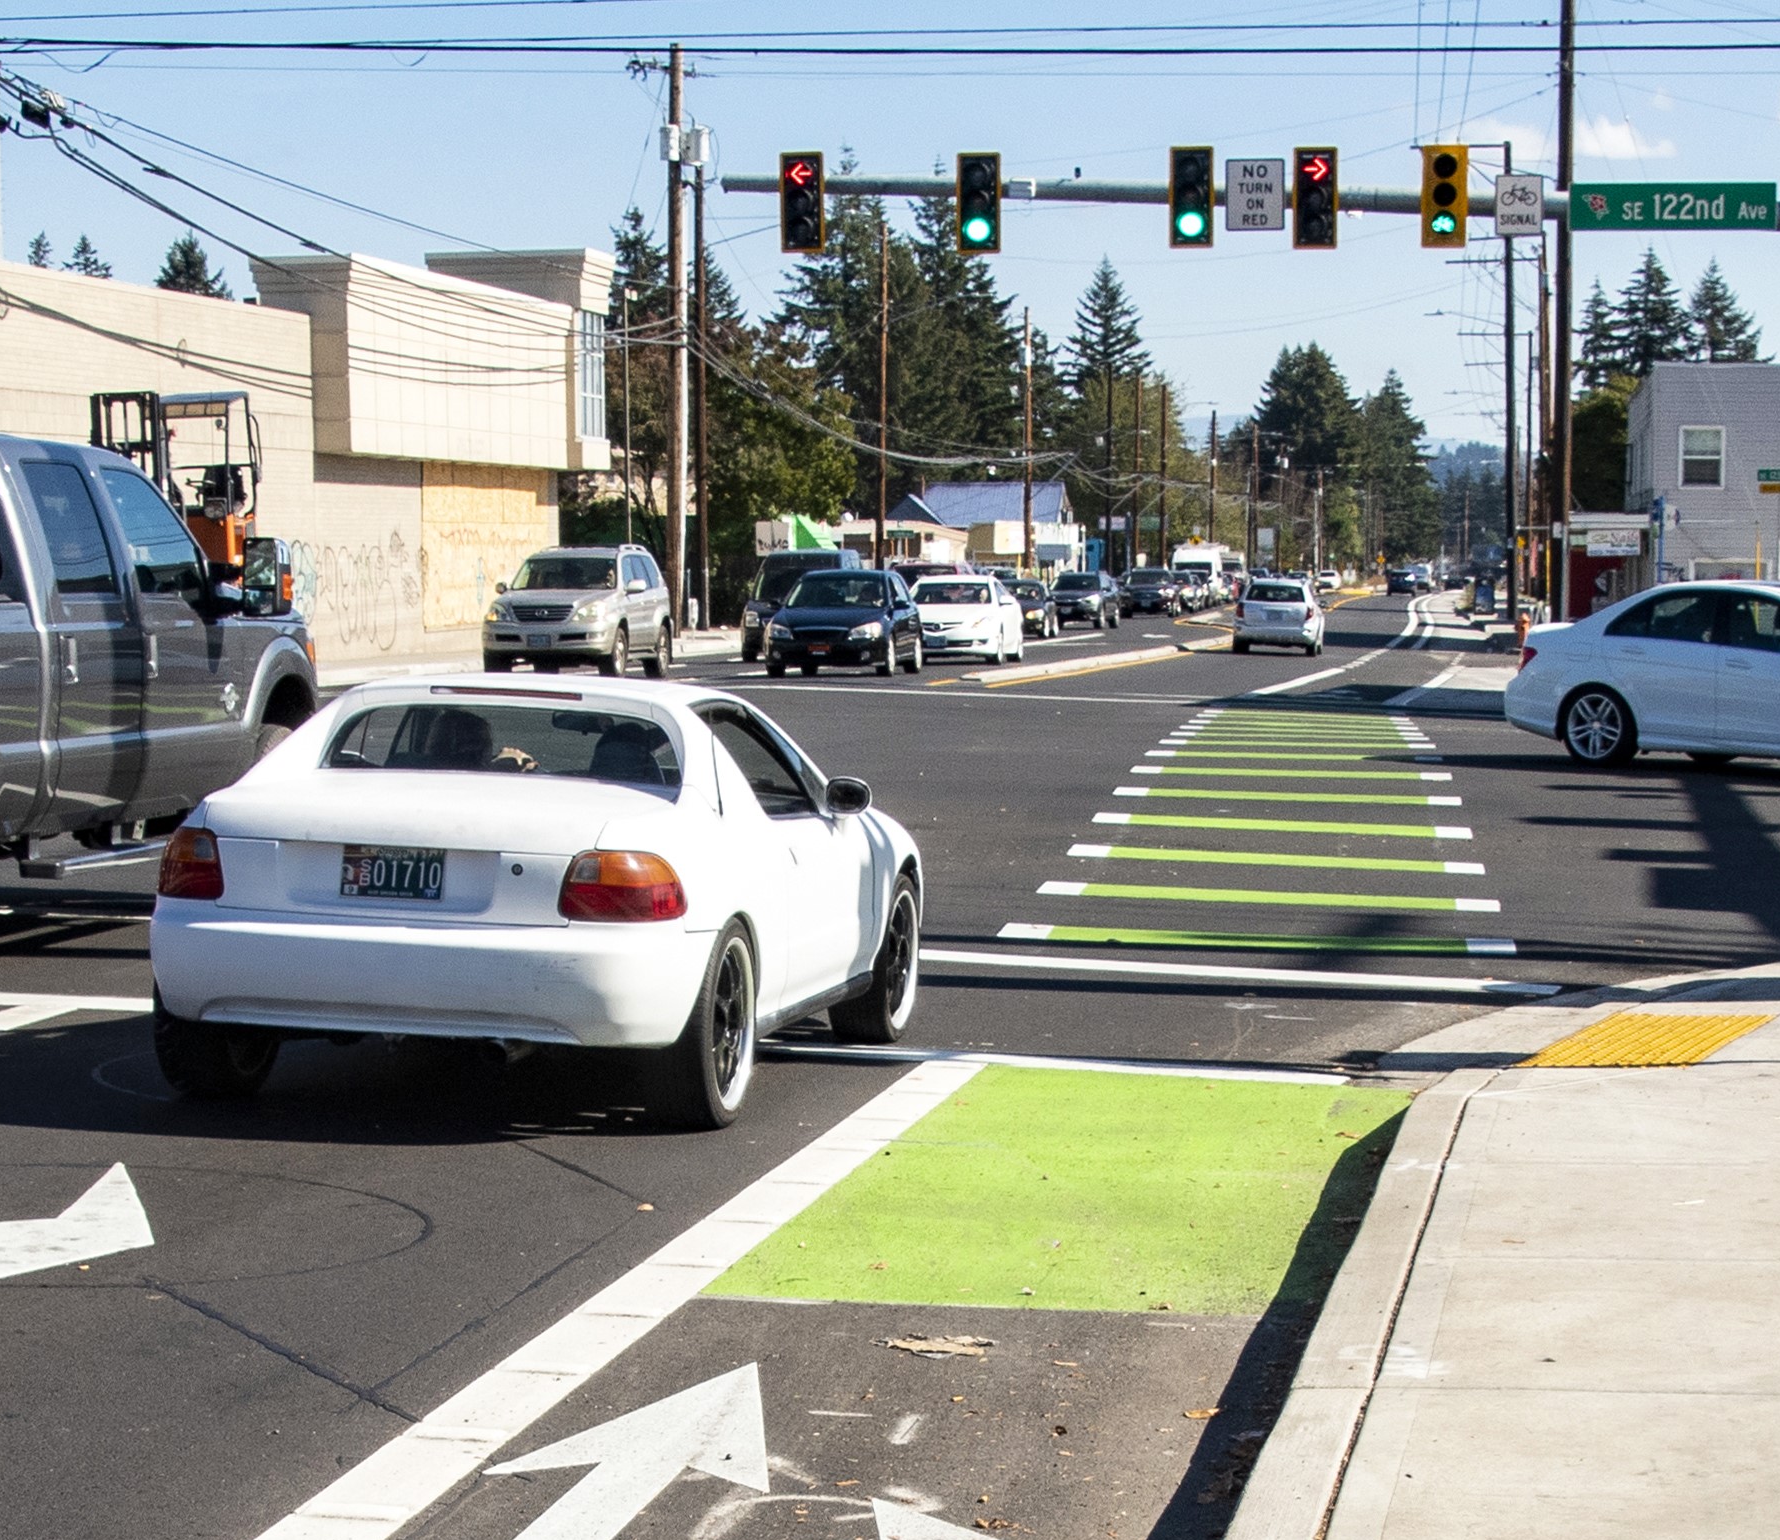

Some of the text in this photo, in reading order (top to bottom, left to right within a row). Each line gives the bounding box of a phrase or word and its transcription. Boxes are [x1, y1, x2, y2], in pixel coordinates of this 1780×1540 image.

[1243, 165, 1267, 178] NO
[1238, 182, 1273, 194] TURN
[1246, 198, 1264, 210] ON
[1622, 192, 1768, 220] SE 122nd Ave
[1242, 214, 1268, 226] RED
[1499, 214, 1538, 227] SIGNAL
[373, 859, 441, 889] 01710
